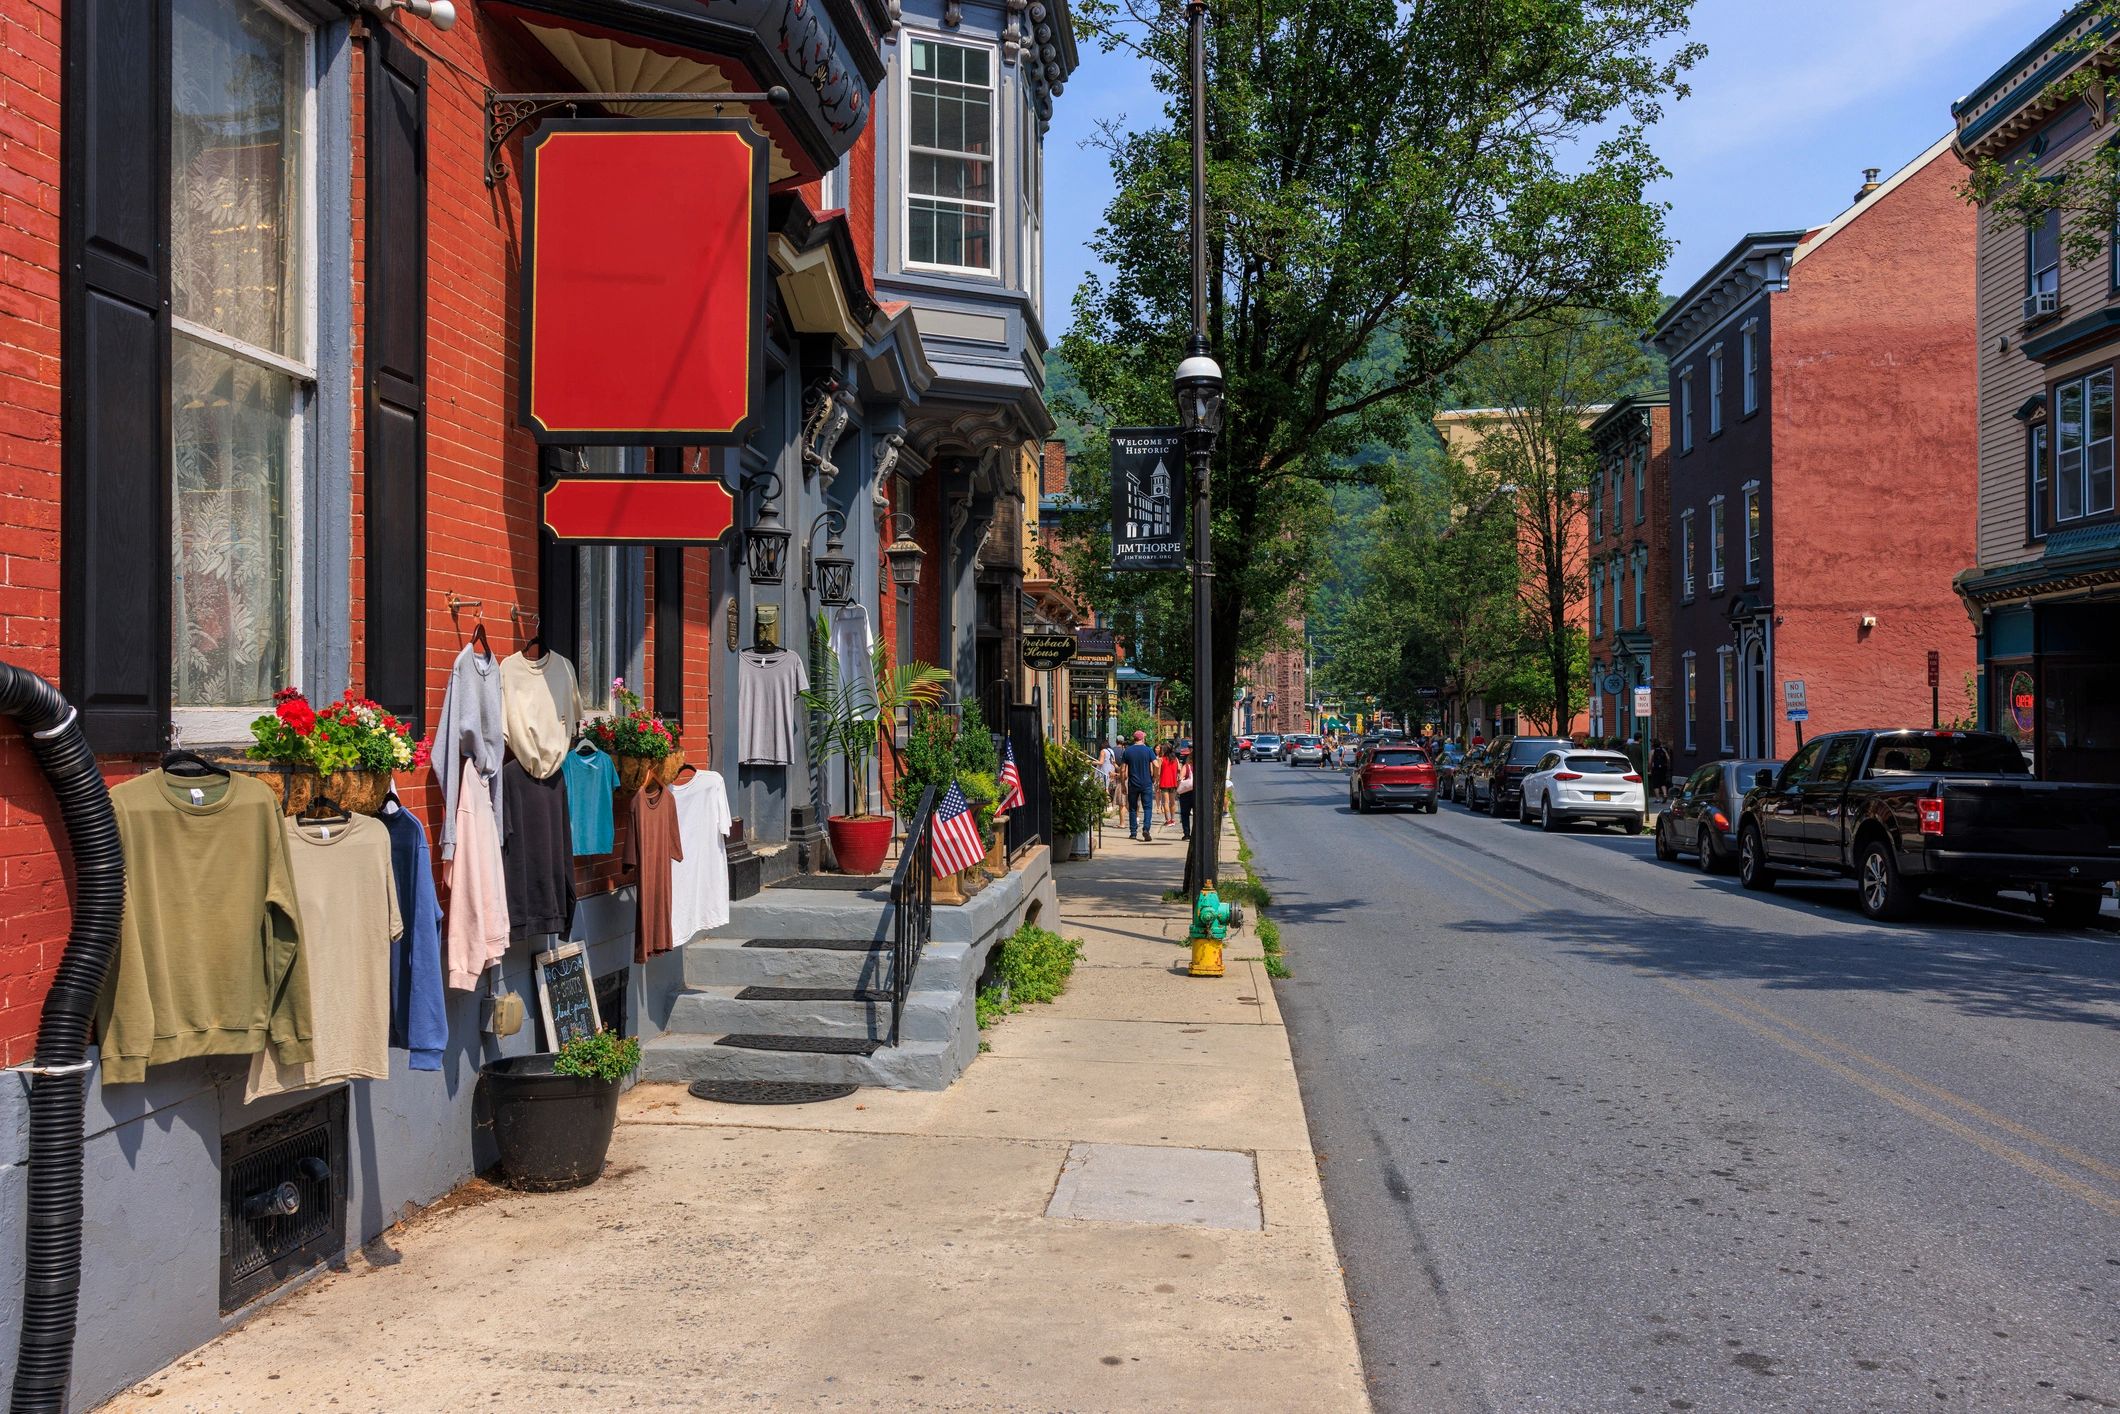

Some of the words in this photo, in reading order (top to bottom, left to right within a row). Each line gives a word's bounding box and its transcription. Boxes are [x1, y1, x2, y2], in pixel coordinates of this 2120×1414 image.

[1116, 438, 1162, 446] WELCOME
[1116, 543, 1134, 555] JIM
[1137, 543, 1181, 553] THORPE
[1023, 647, 1059, 656] House
